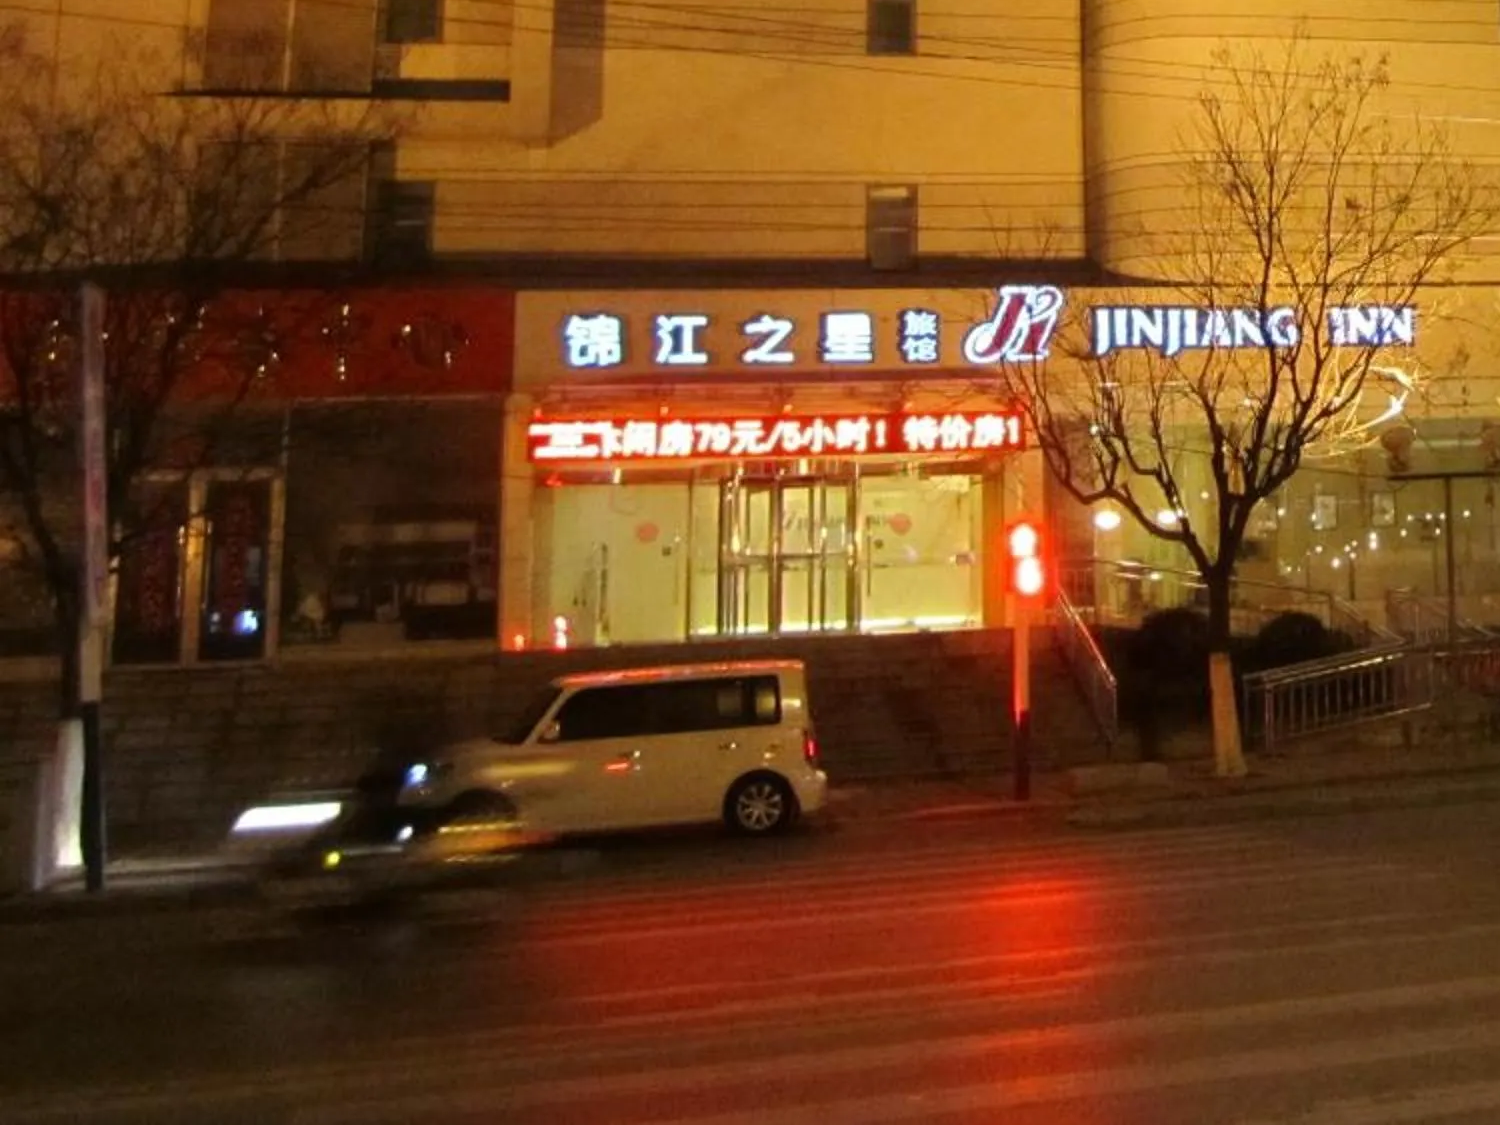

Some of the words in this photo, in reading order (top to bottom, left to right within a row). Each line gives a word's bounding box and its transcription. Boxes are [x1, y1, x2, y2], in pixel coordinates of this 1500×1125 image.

[564, 312, 873, 367] 锦江之星
[1094, 307, 1299, 356] JINJIANG
[1329, 306, 1412, 346] INN
